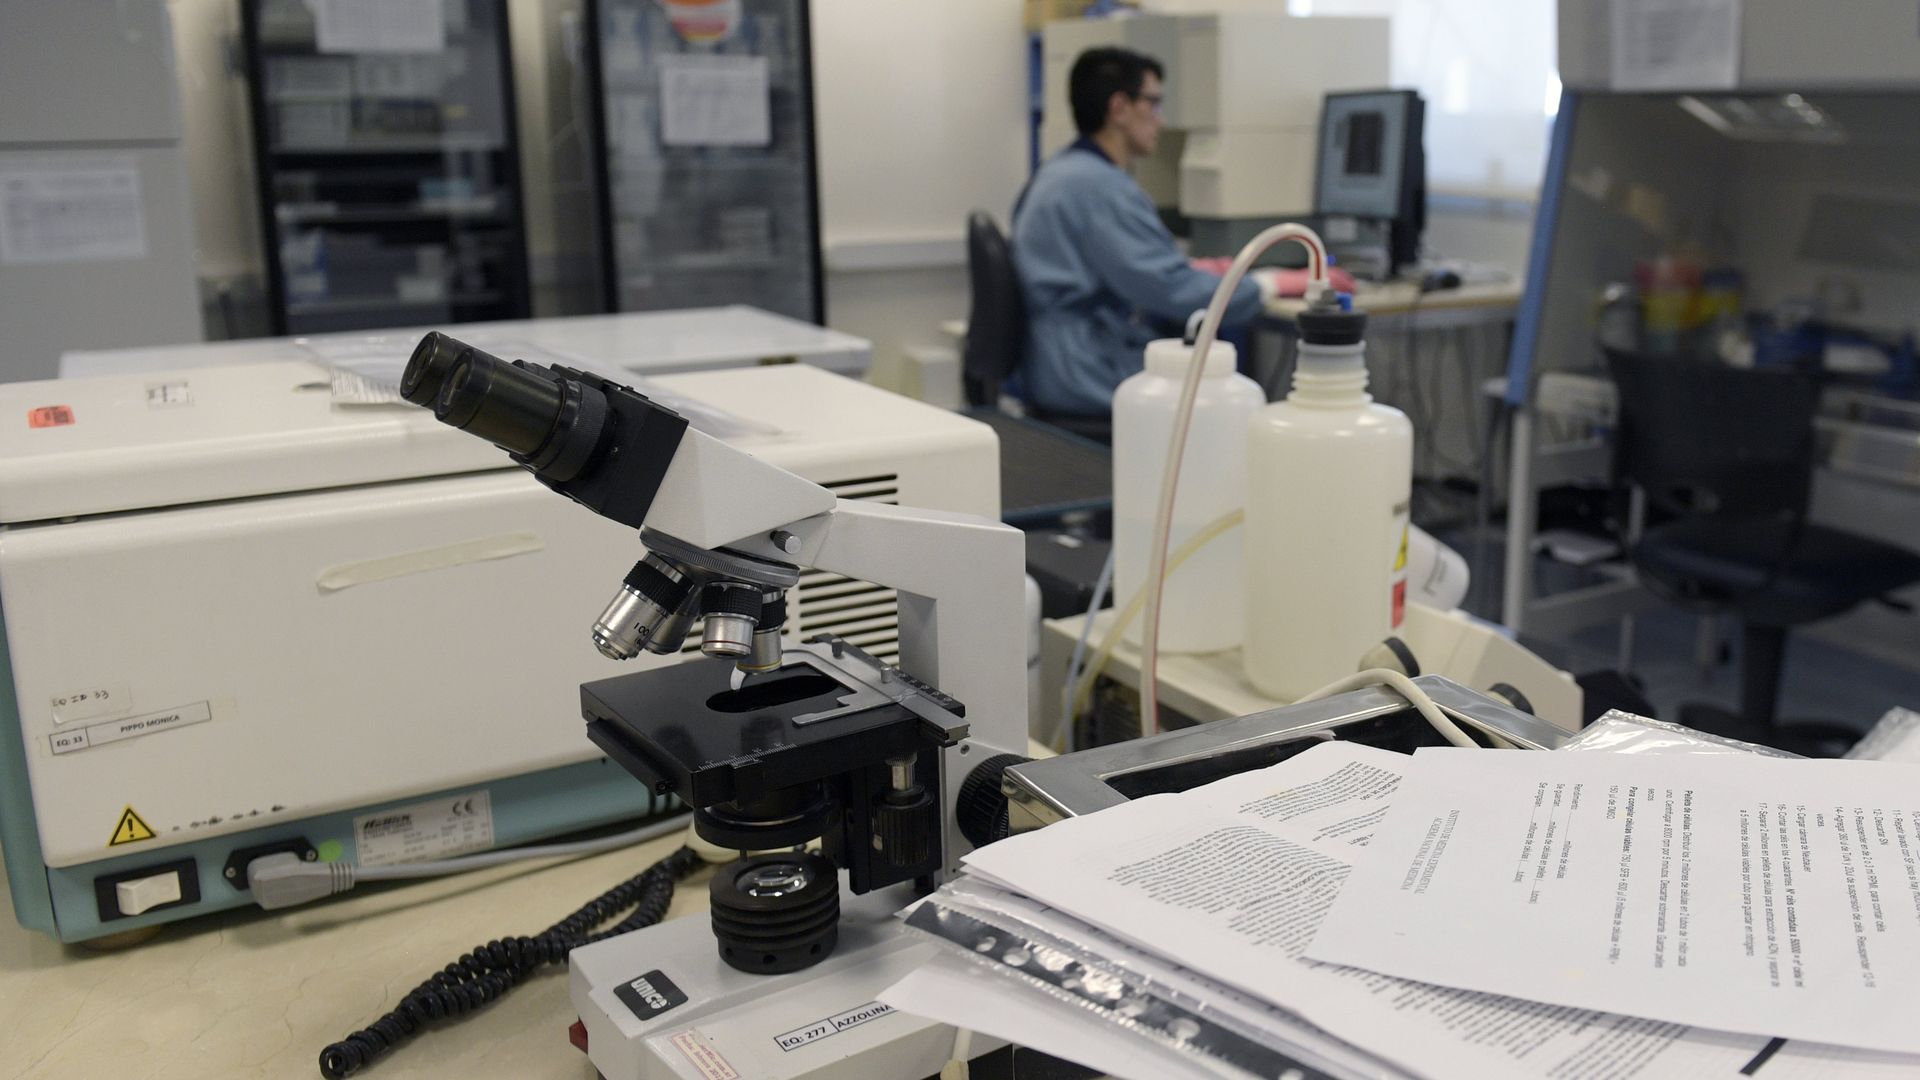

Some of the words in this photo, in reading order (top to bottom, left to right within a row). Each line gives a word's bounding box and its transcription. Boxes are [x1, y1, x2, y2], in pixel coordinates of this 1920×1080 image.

[119, 722, 145, 733] PIPPO
[146, 714, 180, 728] MONICA
[1629, 786, 1638, 797] Para
[1684, 790, 1693, 806] Pellets
[1626, 798, 1636, 817] congelar
[1662, 800, 1674, 824] Centrifugar
[1758, 811, 1768, 829] Separar
[1834, 815, 1845, 832] Agregar
[1855, 815, 1867, 844] Resuspender
[1875, 817, 1885, 838] Descartar
[1623, 835, 1633, 853] viables:
[1796, 813, 1806, 828] Cargar
[1802, 851, 1811, 872] Neubauer
[1778, 812, 1787, 826] Contar
[1787, 907, 1799, 933] contadas
[1869, 891, 1880, 902] para
[1873, 903, 1883, 920] contar
[630, 977, 668, 1010] unico
[837, 1004, 893, 1029] AZZOLINA
[781, 1036, 804, 1048] EQ:
[804, 1026, 826, 1039] 277
